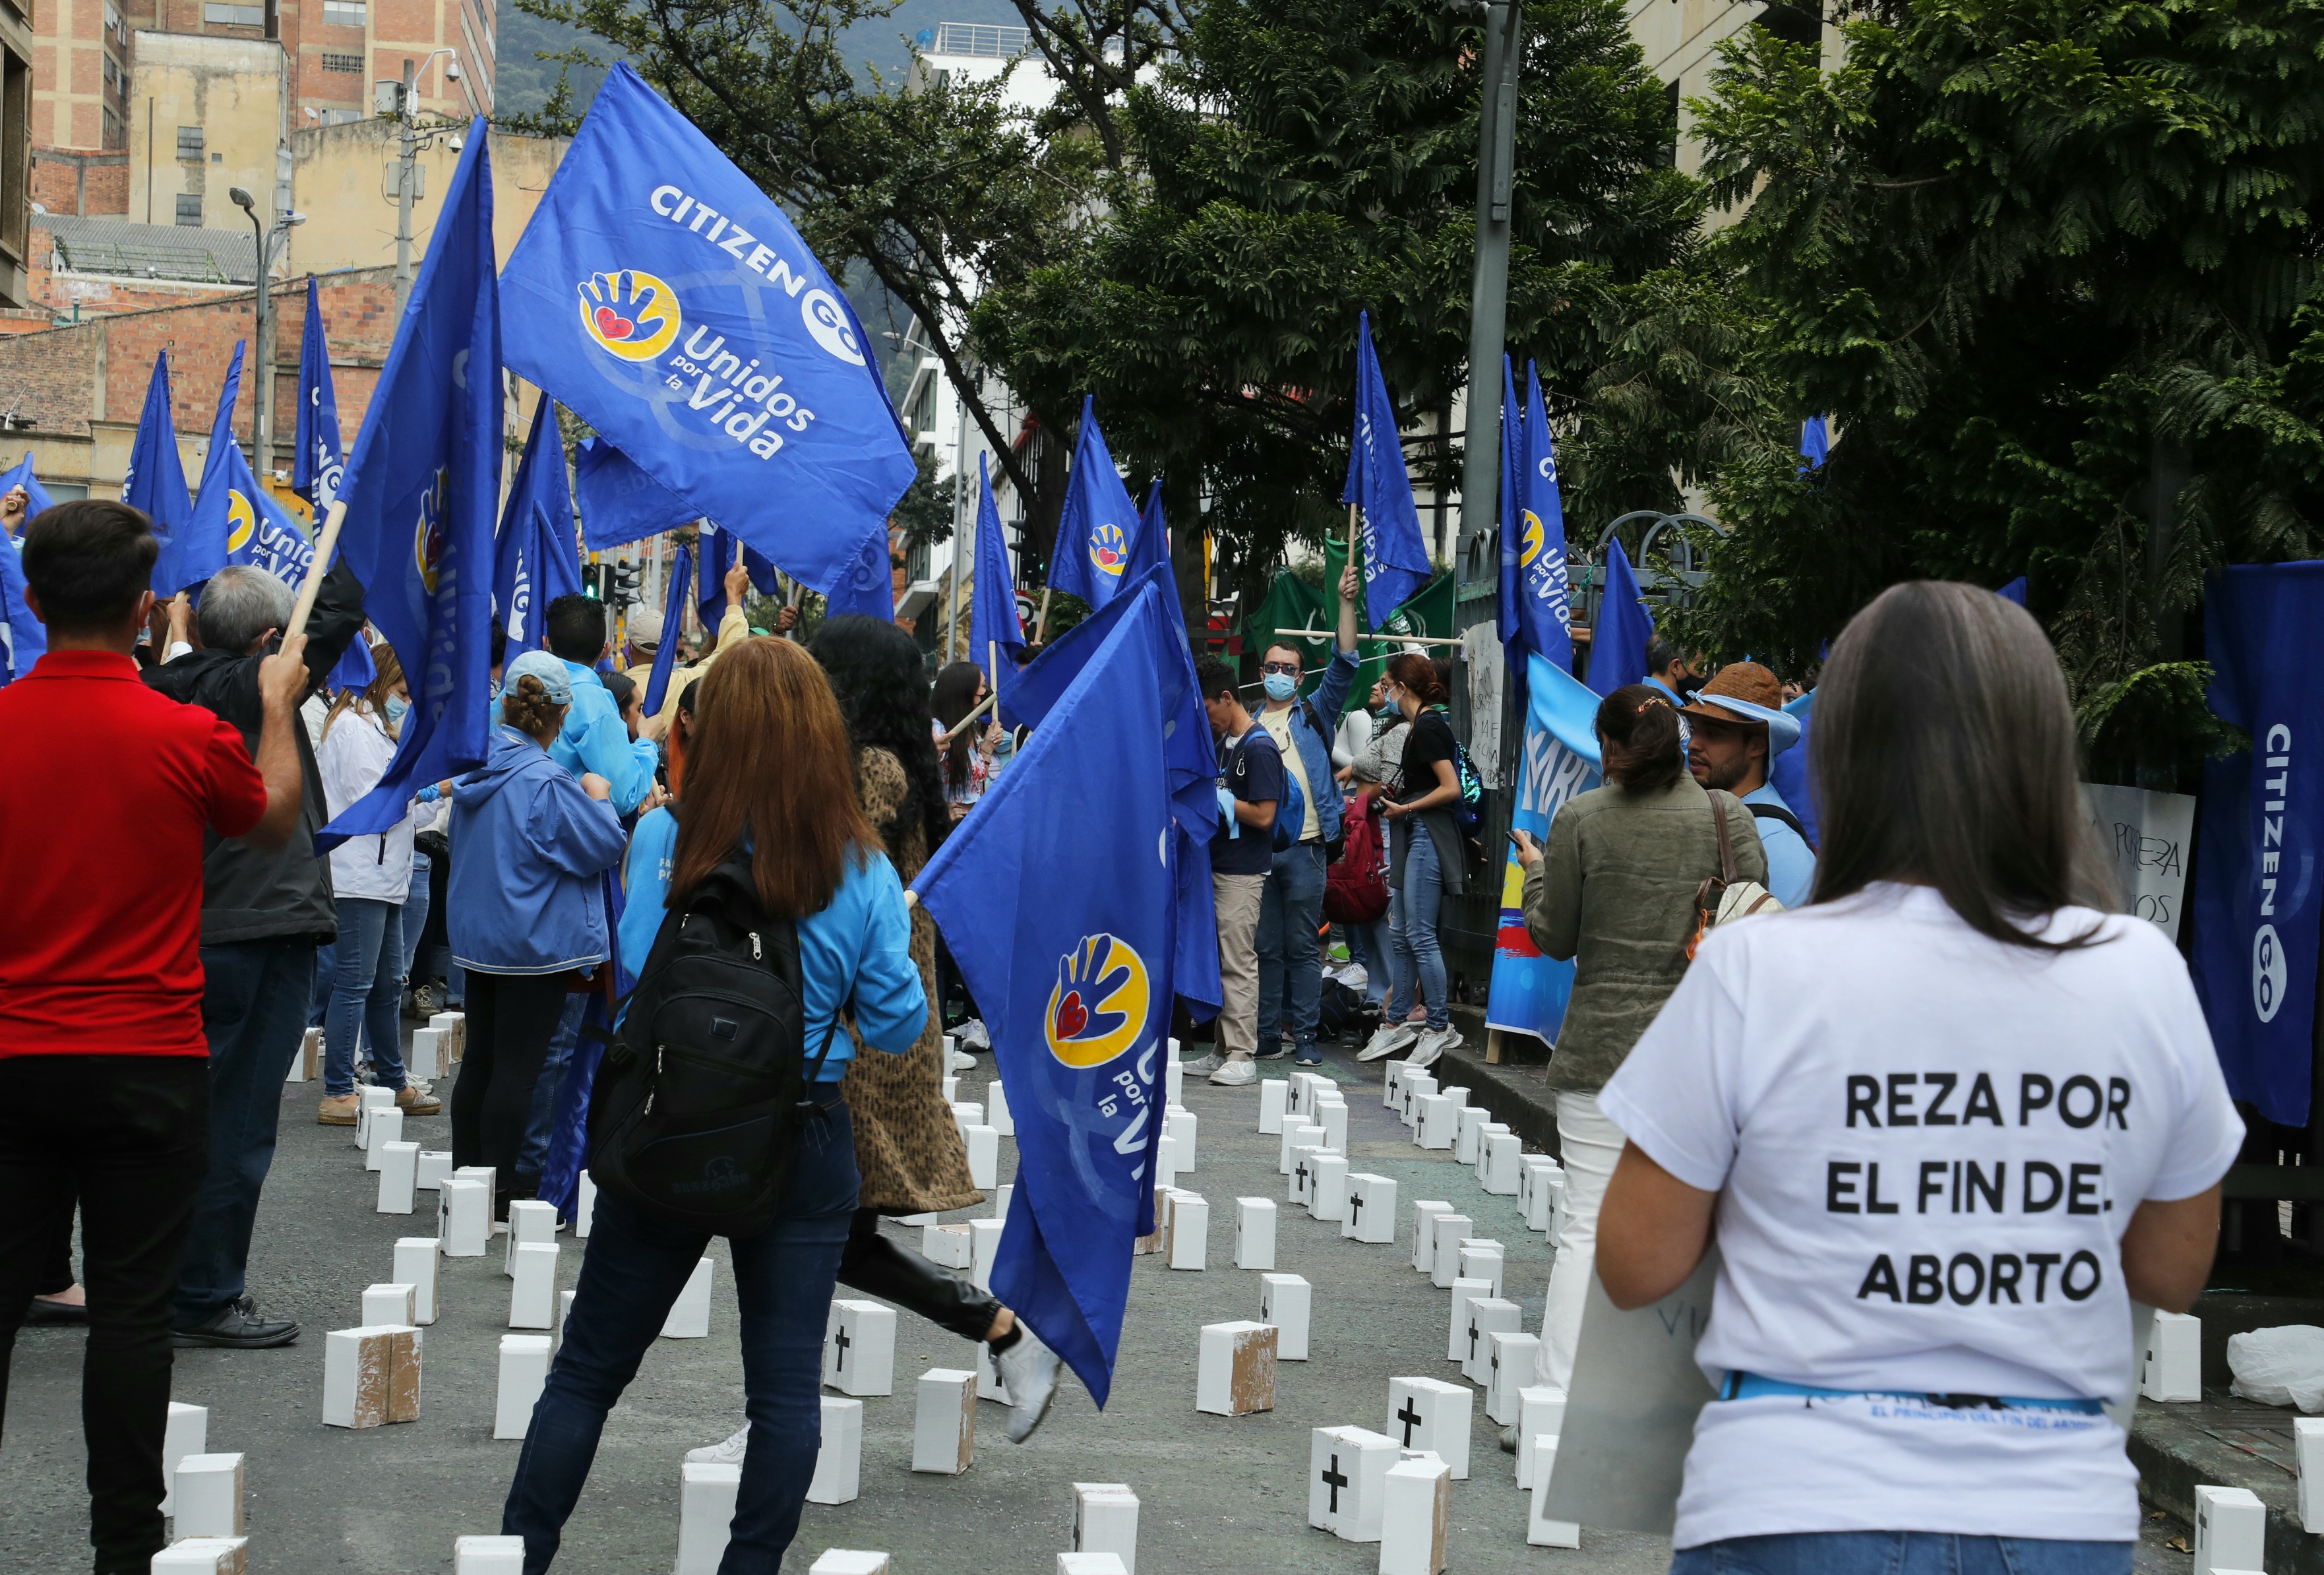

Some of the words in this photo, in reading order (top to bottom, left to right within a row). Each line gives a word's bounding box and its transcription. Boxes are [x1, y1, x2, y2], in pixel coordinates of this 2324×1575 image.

[669, 354, 702, 377] por
[684, 324, 816, 432] Unidos
[664, 373, 683, 390] la
[687, 373, 784, 460] Vida
[251, 543, 272, 559] por
[1528, 573, 1539, 586] la
[1532, 563, 1550, 579] por
[1112, 1069, 1146, 1106] por
[1845, 1072, 2003, 1129] REZA
[2019, 1073, 2131, 1131] POR
[1097, 1093, 1118, 1119] la
[1827, 1161, 1899, 1215] EL
[1917, 1160, 2005, 1214] FIN
[2023, 1161, 2112, 1215] DE
[1856, 1249, 2102, 1306] ABORTO
